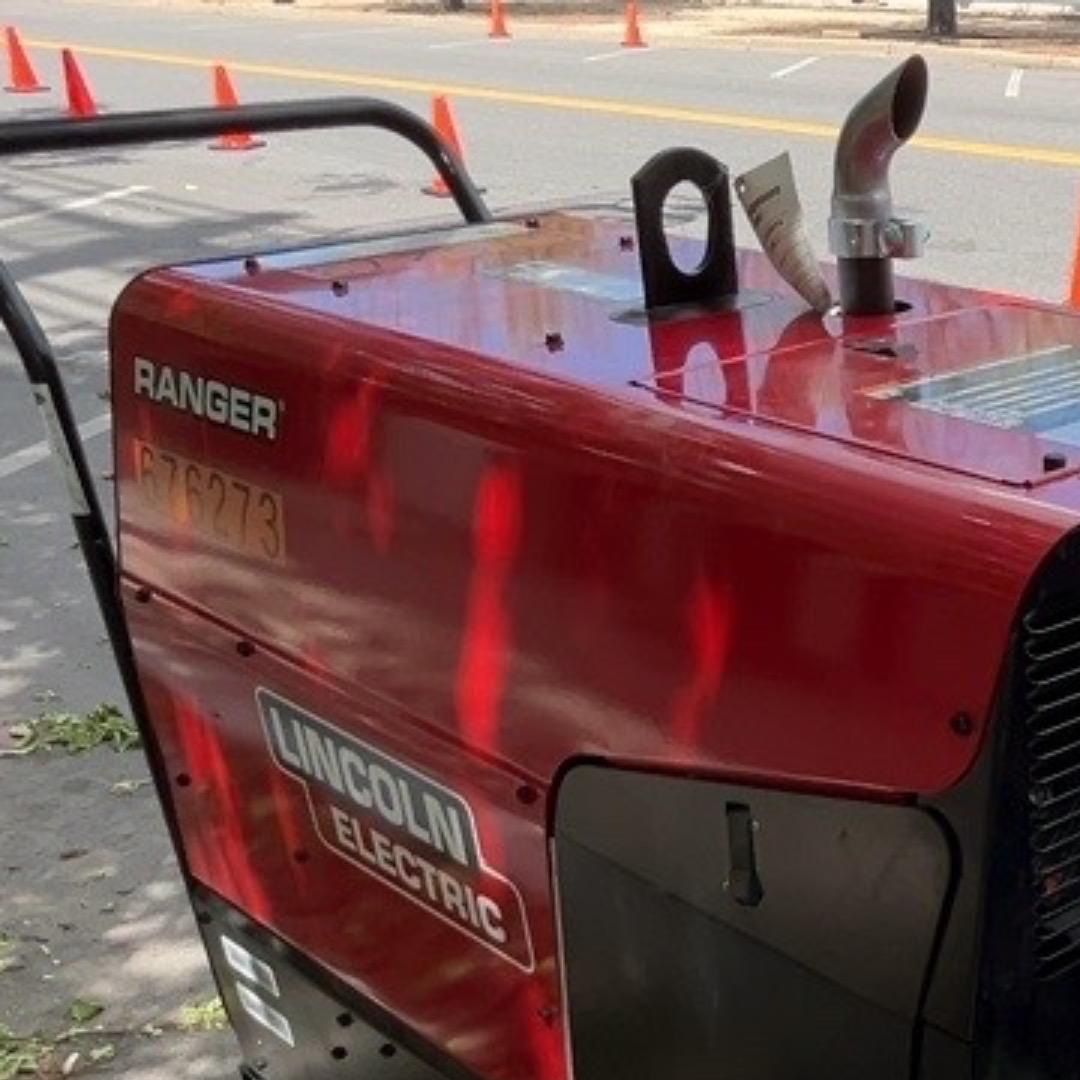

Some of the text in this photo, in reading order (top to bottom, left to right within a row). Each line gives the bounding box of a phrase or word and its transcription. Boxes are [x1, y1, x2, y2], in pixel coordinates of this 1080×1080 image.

[133, 356, 278, 440] RANGER
[269, 706, 469, 867] LINCOLN
[329, 805, 508, 944] ELECTRIC
